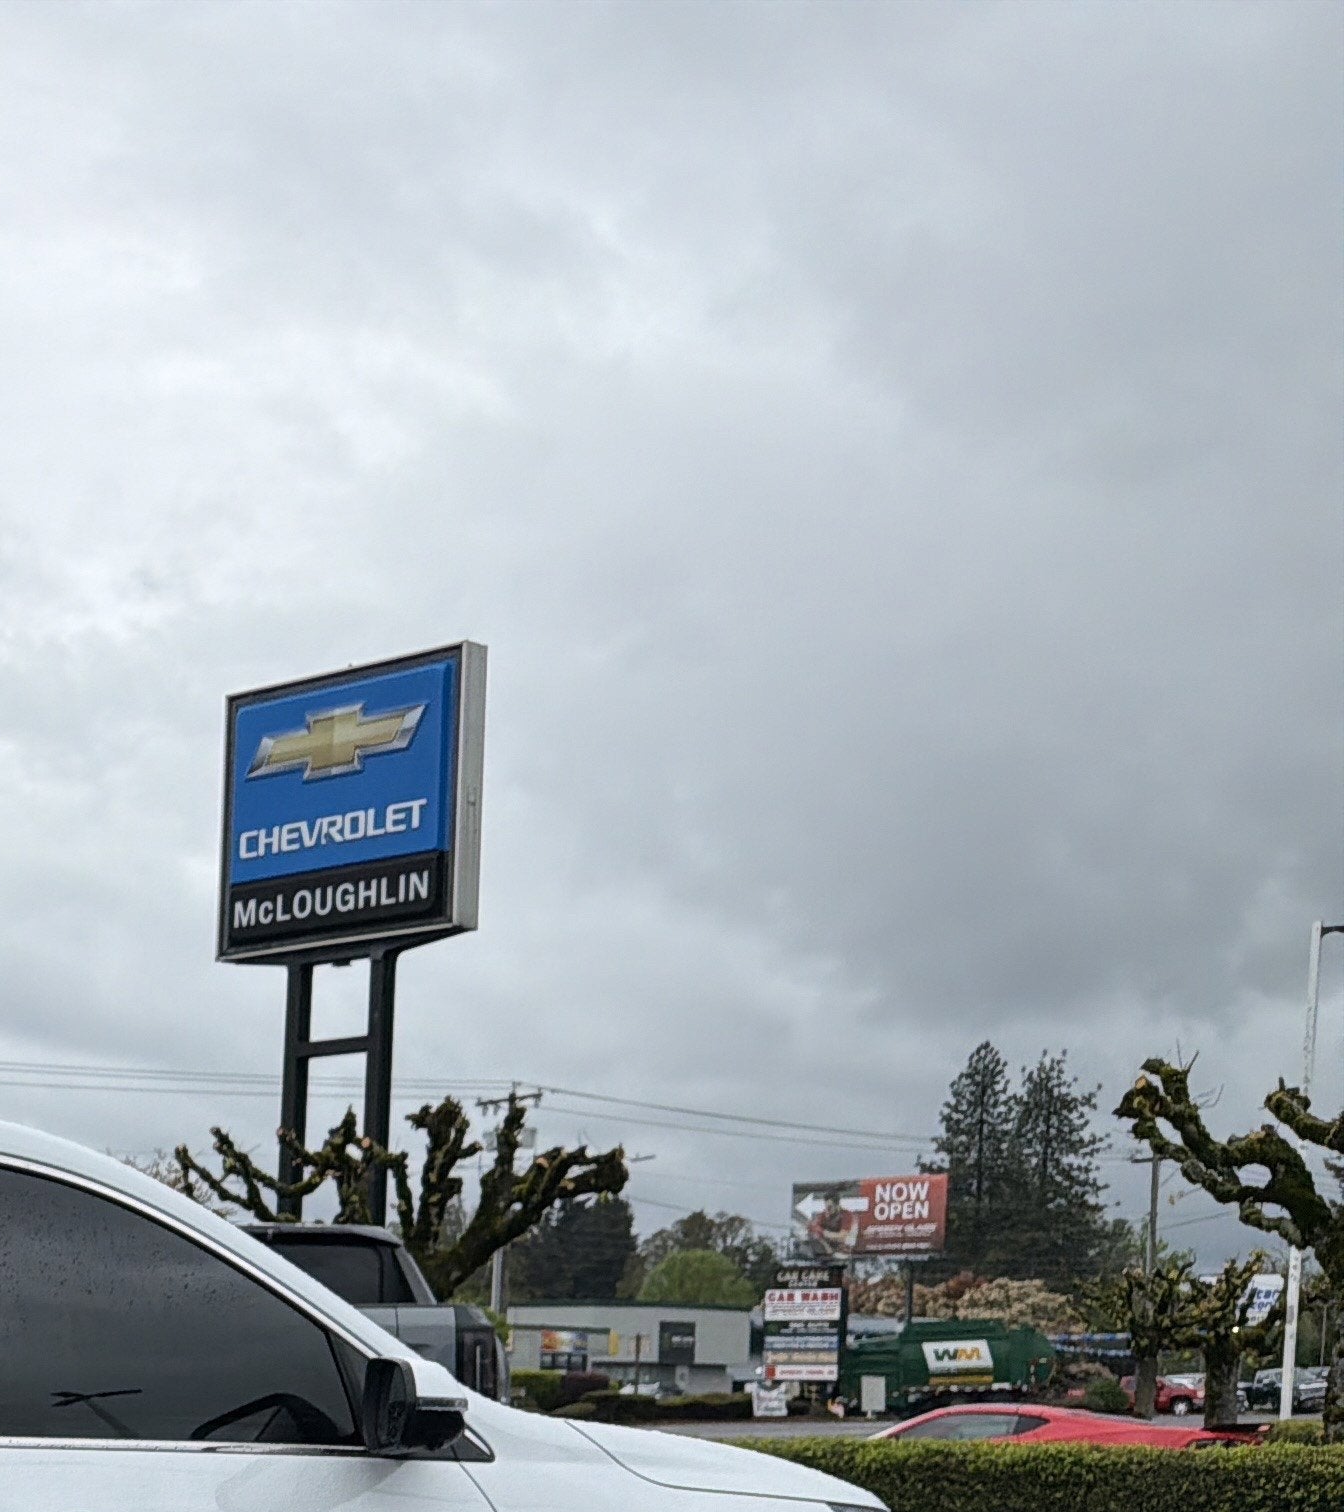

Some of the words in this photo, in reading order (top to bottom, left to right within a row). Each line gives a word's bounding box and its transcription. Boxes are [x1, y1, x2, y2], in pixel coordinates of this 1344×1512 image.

[238, 798, 428, 859] CHEVROLET
[233, 869, 430, 929] McLOUGHLIN
[875, 1181, 929, 1202] NOW
[874, 1200, 929, 1220] OPEN
[767, 1292, 795, 1302] CAR
[801, 1292, 839, 1302] WASH
[933, 1347, 980, 1361] WM
